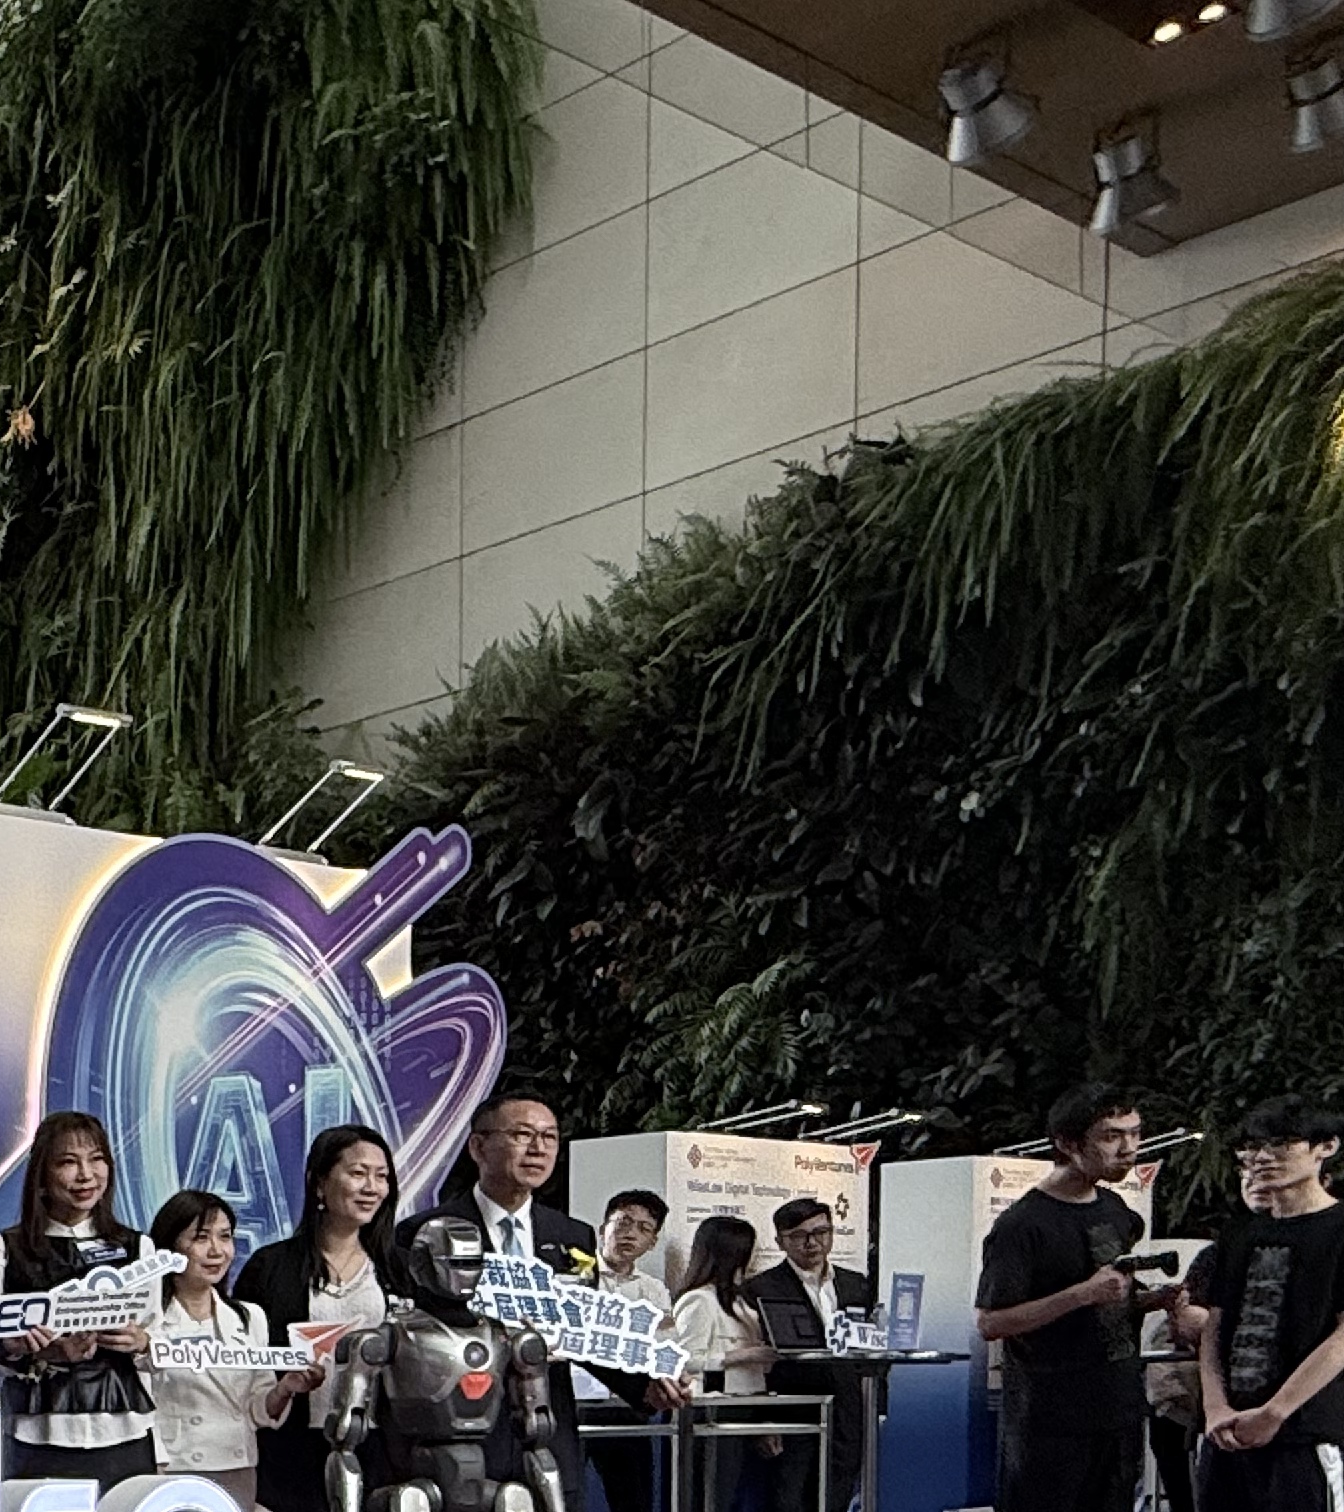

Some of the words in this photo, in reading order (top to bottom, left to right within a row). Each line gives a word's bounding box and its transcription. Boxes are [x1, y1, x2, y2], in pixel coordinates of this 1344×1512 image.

[480, 1256, 551, 1292] 裁協會
[155, 1340, 310, 1370] PolyVentures
